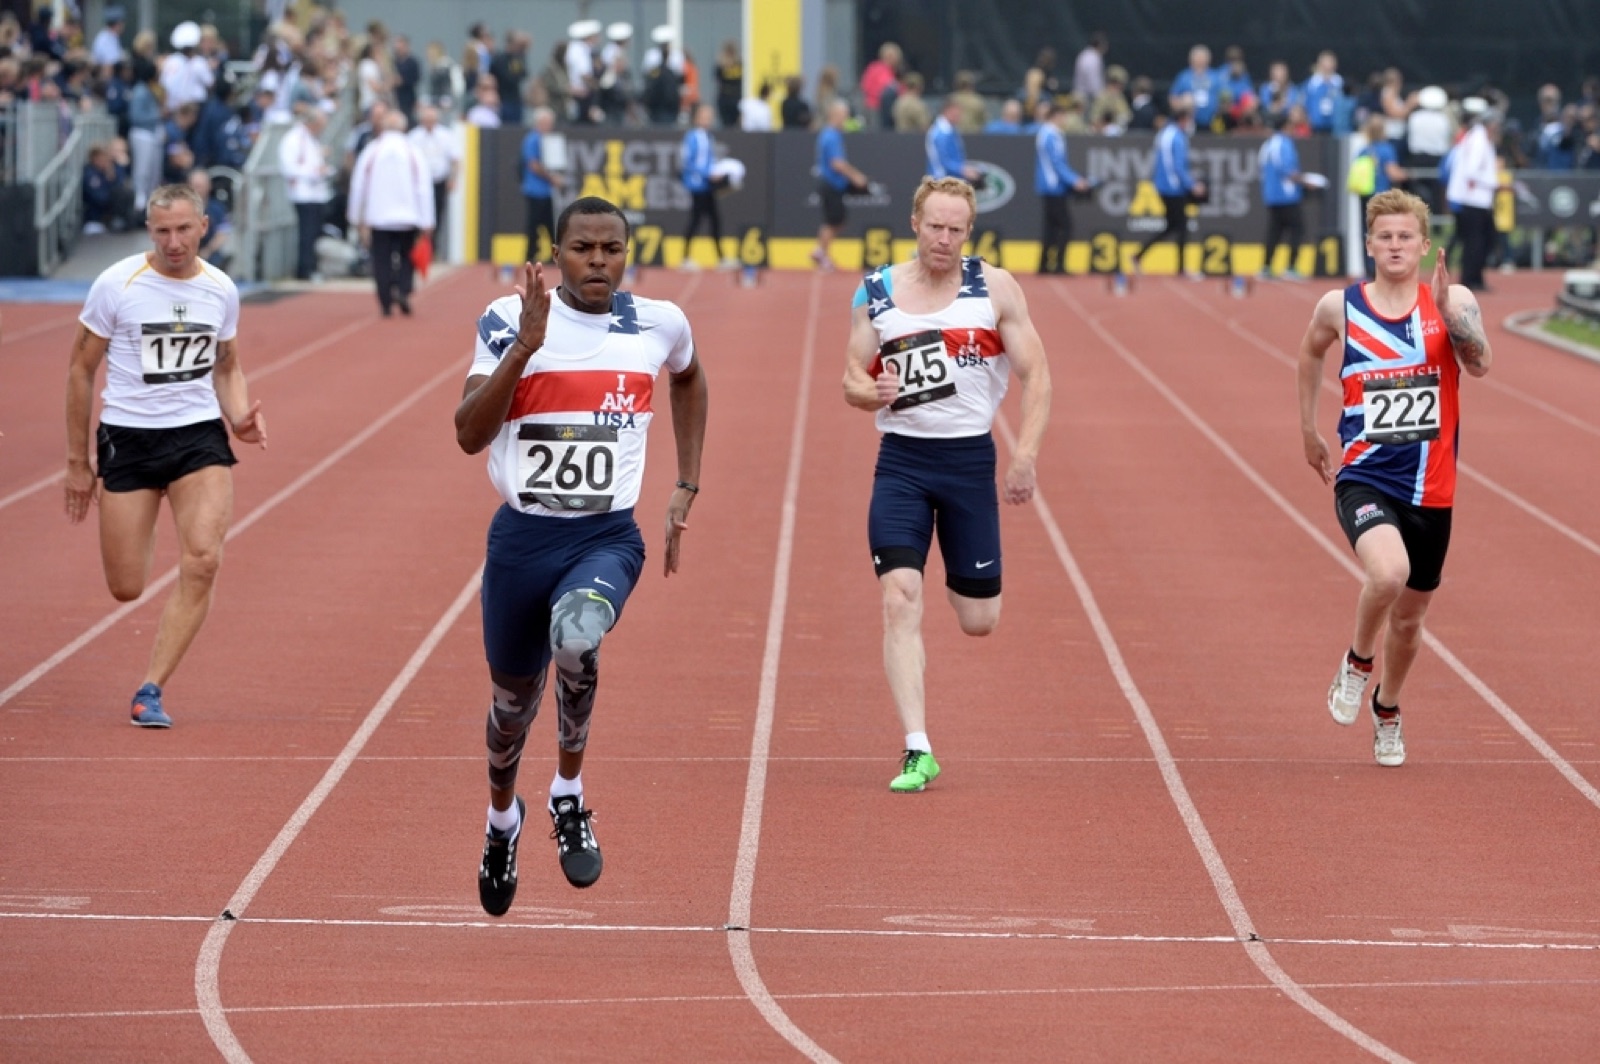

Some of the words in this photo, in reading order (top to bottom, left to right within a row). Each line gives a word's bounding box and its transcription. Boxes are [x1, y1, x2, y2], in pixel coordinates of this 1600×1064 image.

[637, 227, 662, 264] 7
[741, 228, 765, 266] 6
[865, 229, 892, 267] 5
[1092, 233, 1118, 271] 3
[1204, 236, 1230, 273] 2
[1320, 238, 1338, 275] 1
[150, 335, 212, 370] 172
[967, 330, 976, 345] I
[617, 374, 626, 392] I
[594, 411, 636, 429] USA
[600, 392, 635, 412] AM
[1371, 390, 1437, 429] 222
[525, 444, 613, 491] 260
